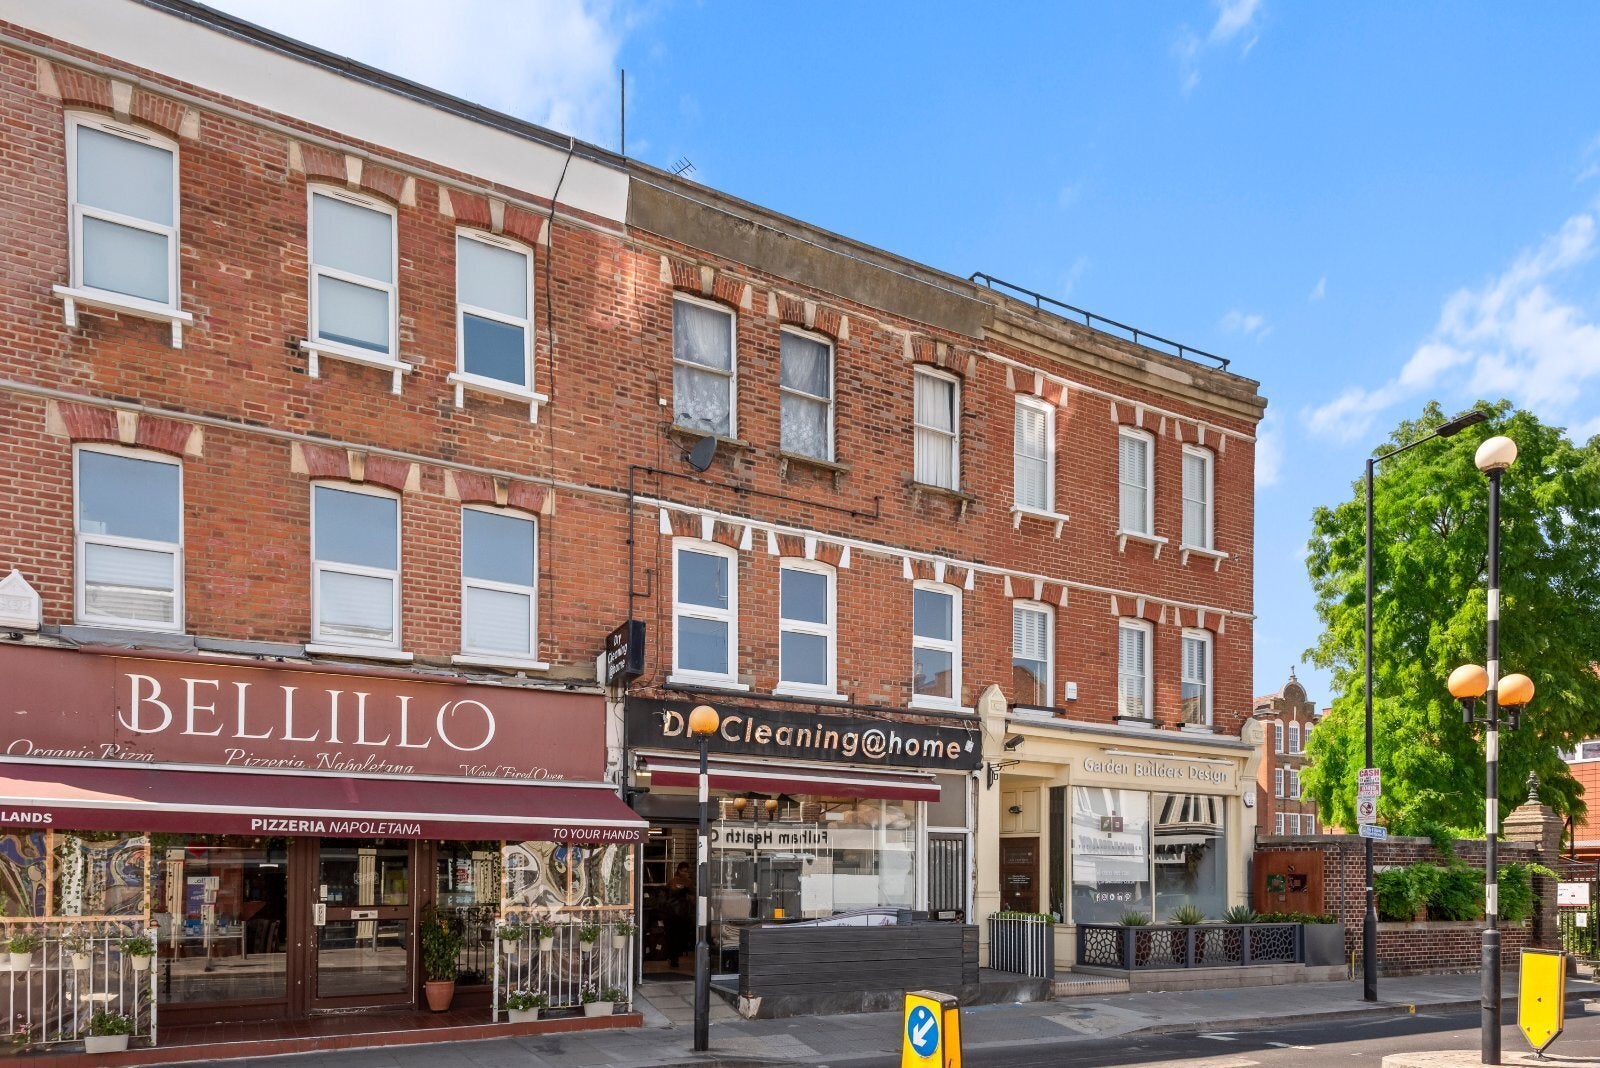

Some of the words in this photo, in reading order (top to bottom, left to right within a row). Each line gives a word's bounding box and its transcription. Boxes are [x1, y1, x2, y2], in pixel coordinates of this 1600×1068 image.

[118, 673, 497, 752] BELLILLO
[224, 748, 306, 768] Pizzeria
[1084, 757, 1128, 775] Garden
[1135, 762, 1184, 779] Builders
[1189, 765, 1228, 784] Design
[1360, 769, 1379, 777] CASH
[251, 818, 326, 833] PIZZERIA
[328, 820, 422, 837] NAPOLETANA
[553, 828, 567, 839] TO
[571, 828, 600, 841] YOUR
[602, 829, 640, 841] HANDS
